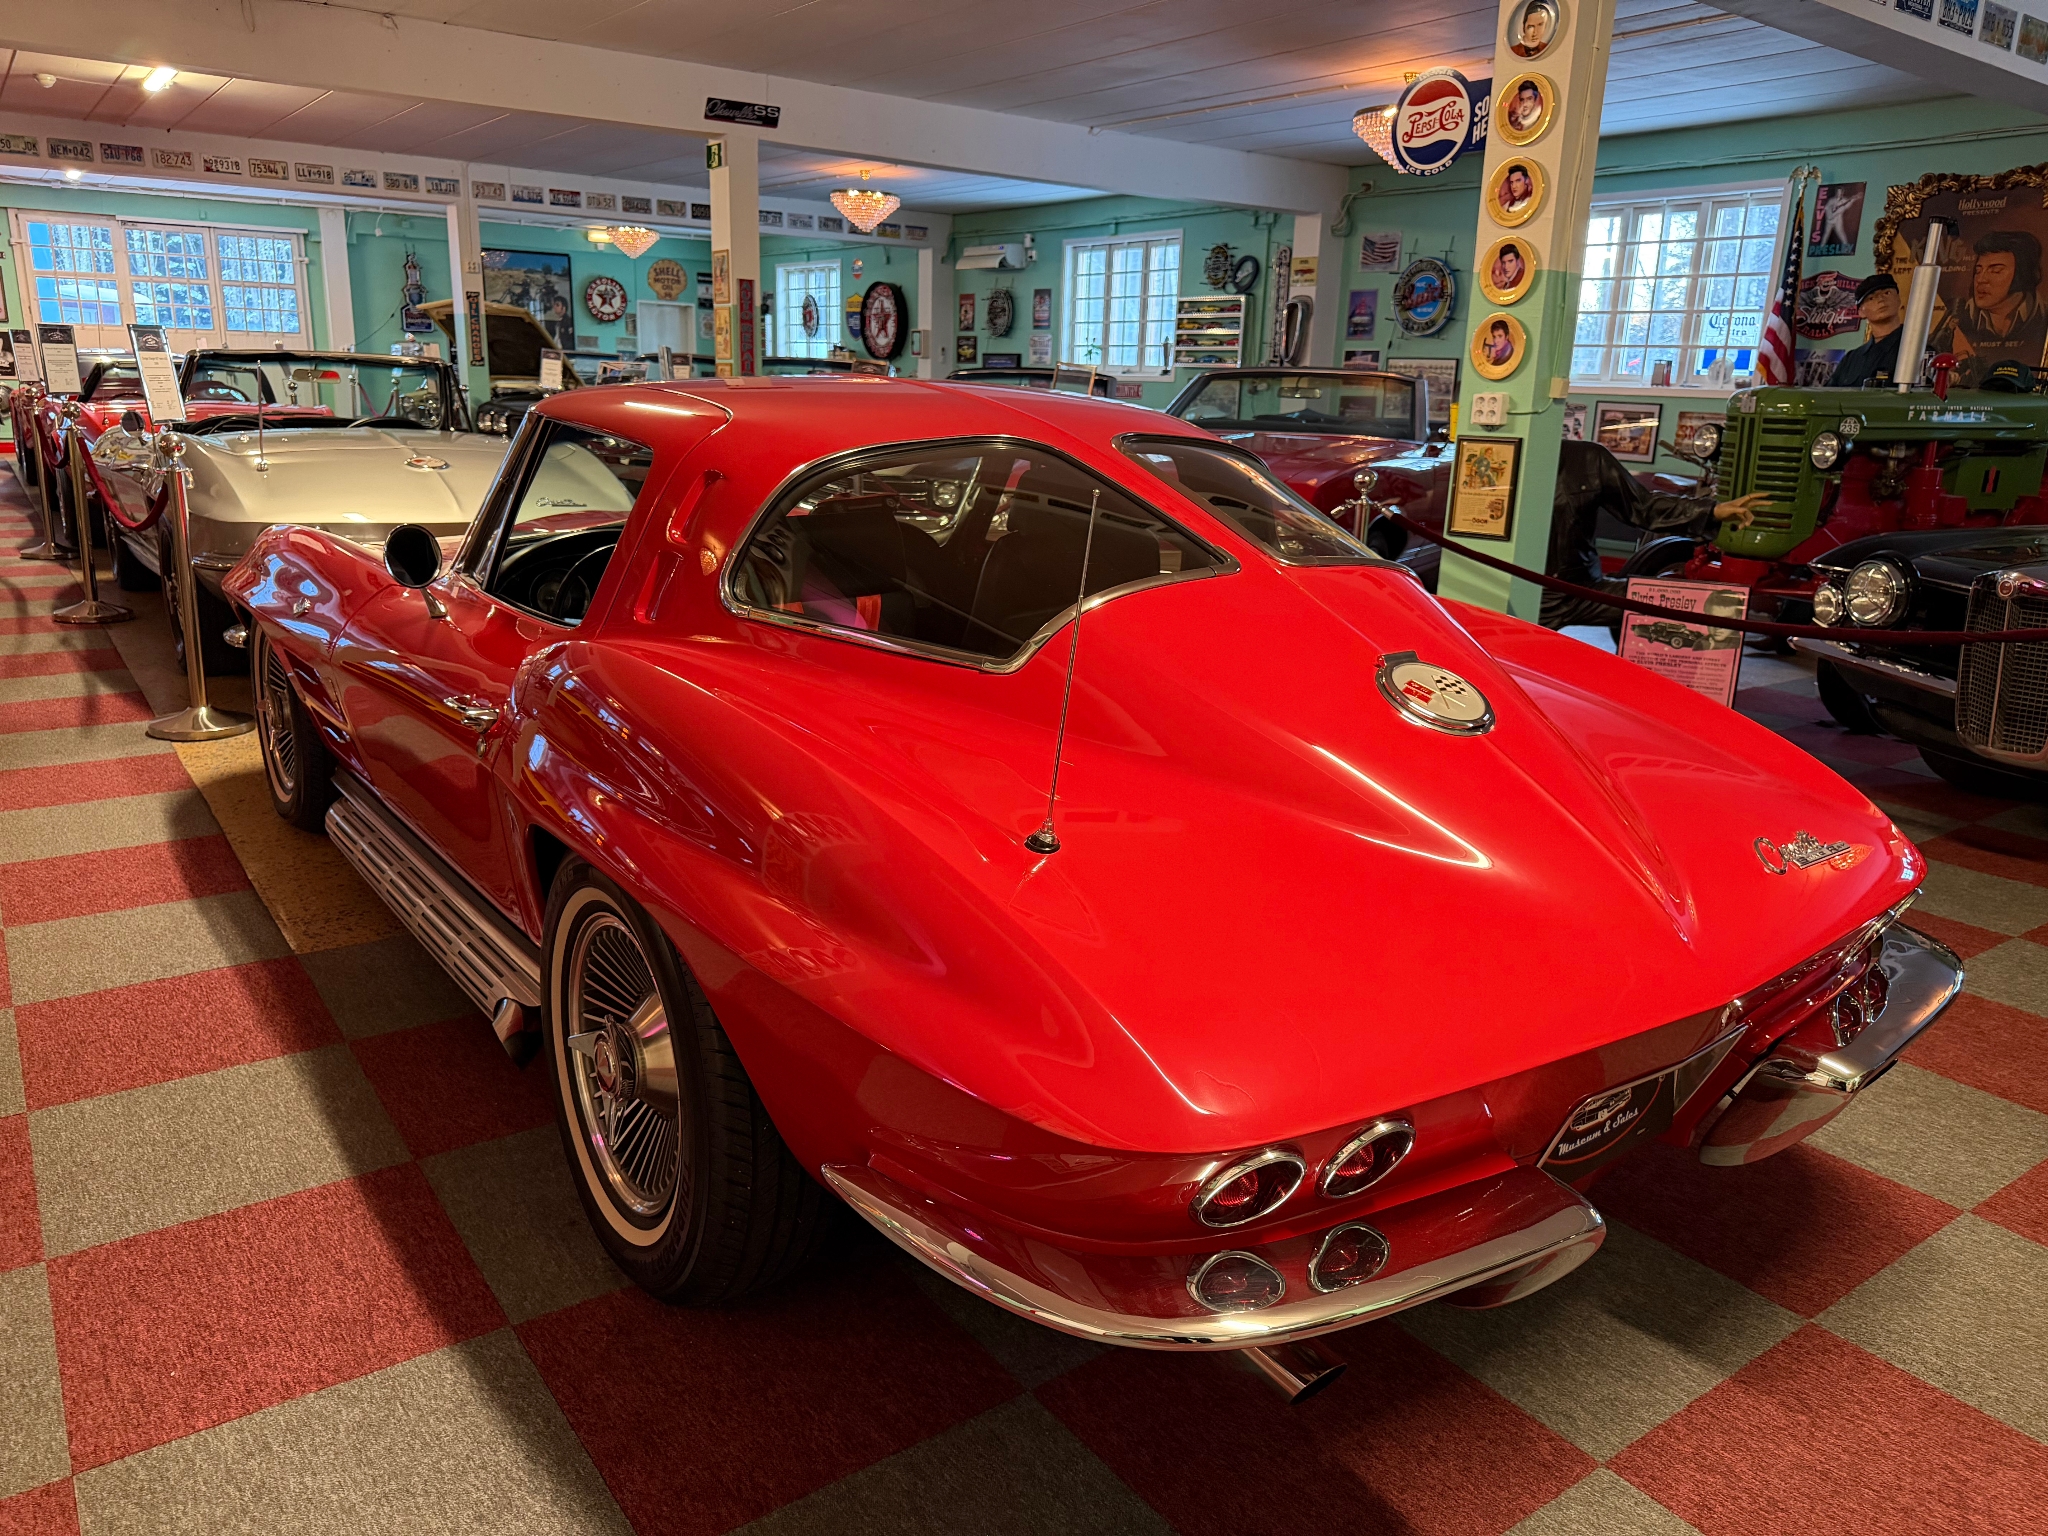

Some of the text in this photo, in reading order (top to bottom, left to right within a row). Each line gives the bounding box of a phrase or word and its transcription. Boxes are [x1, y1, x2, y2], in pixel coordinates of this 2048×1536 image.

[754, 105, 779, 119] SS
[1405, 159, 1453, 176] ICE COLD
[1958, 196, 2007, 211] Hollywood
[1811, 186, 1829, 243] ELVIS
[1808, 243, 1855, 256] PRESLEY
[653, 267, 681, 277] SHELL
[587, 277, 626, 299] GASOLINE
[653, 277, 682, 285] MOTOR
[662, 284, 674, 292] OIL
[587, 299, 627, 321] MOTOR OIL
[740, 281, 753, 325] AUTO
[1907, 410, 1988, 422] FARMALL
[1841, 424, 1859, 433] 235
[1659, 594, 1697, 612] Presley
[1558, 1107, 1639, 1156] Museum & Sales
